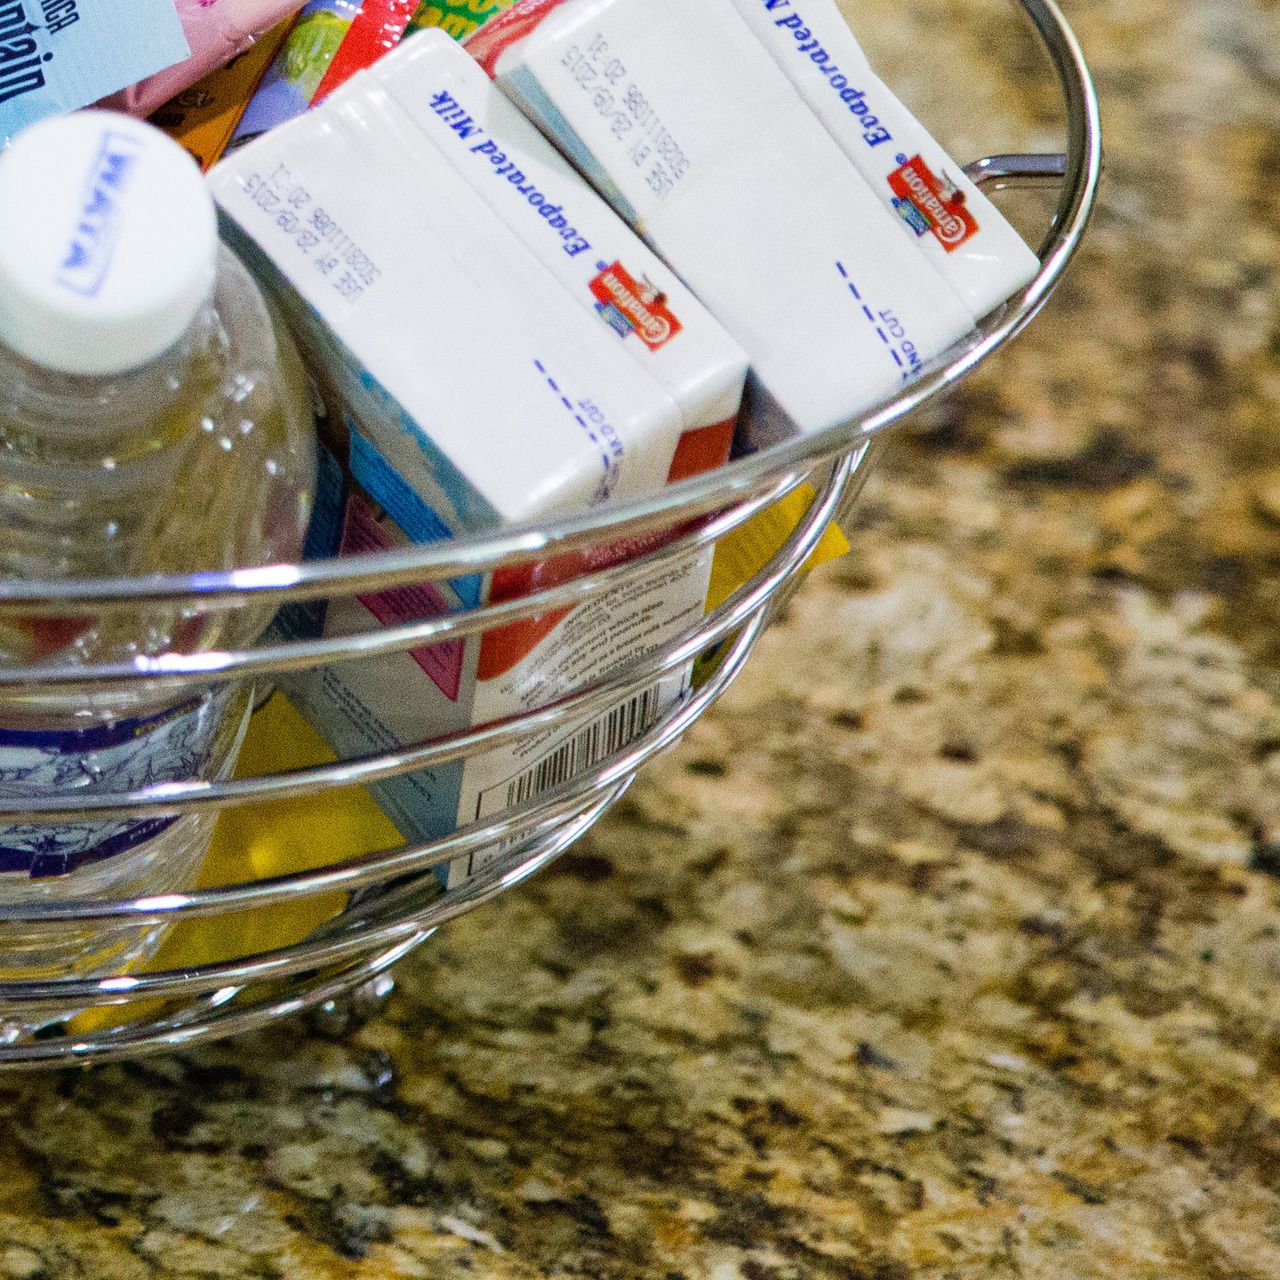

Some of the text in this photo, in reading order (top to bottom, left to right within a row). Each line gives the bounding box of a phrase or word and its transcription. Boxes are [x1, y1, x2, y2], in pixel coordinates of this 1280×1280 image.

[774, 11, 894, 150] Evaporated
[428, 88, 485, 144] Milk
[623, 136, 655, 168] BY
[471, 137, 595, 258] Evaporated
[639, 159, 676, 198] USE
[901, 162, 967, 247] Carnation
[311, 248, 341, 277] BY
[330, 269, 366, 306] USE
[600, 270, 672, 344] Carnation
[876, 308, 908, 345] CUT
[577, 397, 608, 427] CUT
